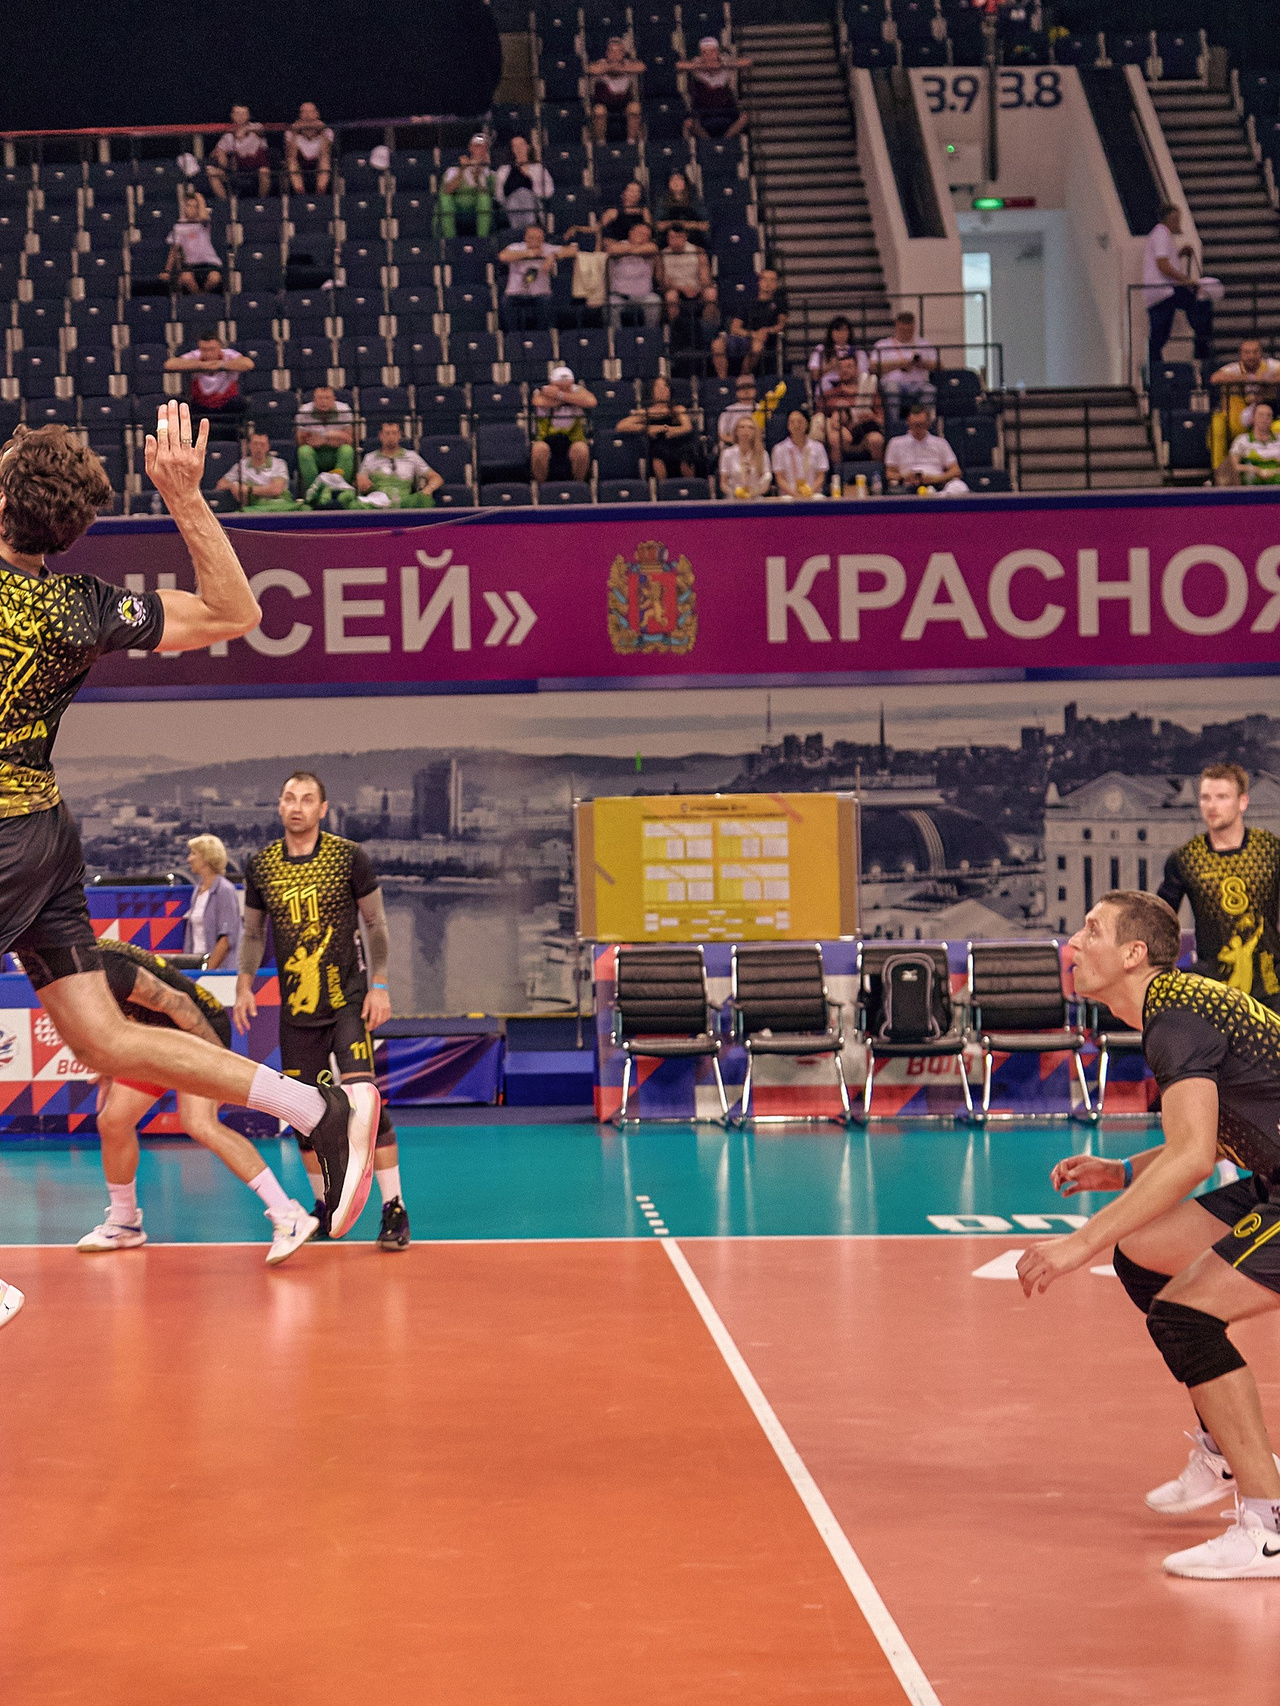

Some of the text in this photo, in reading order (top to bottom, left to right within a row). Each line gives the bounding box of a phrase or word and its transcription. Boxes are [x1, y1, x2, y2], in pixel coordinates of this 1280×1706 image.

[922, 75, 979, 113] 3.9
[999, 70, 1063, 108] 3.8
[282, 884, 319, 924] 11
[1221, 876, 1249, 916] 8
[349, 1041, 369, 1060] 11
